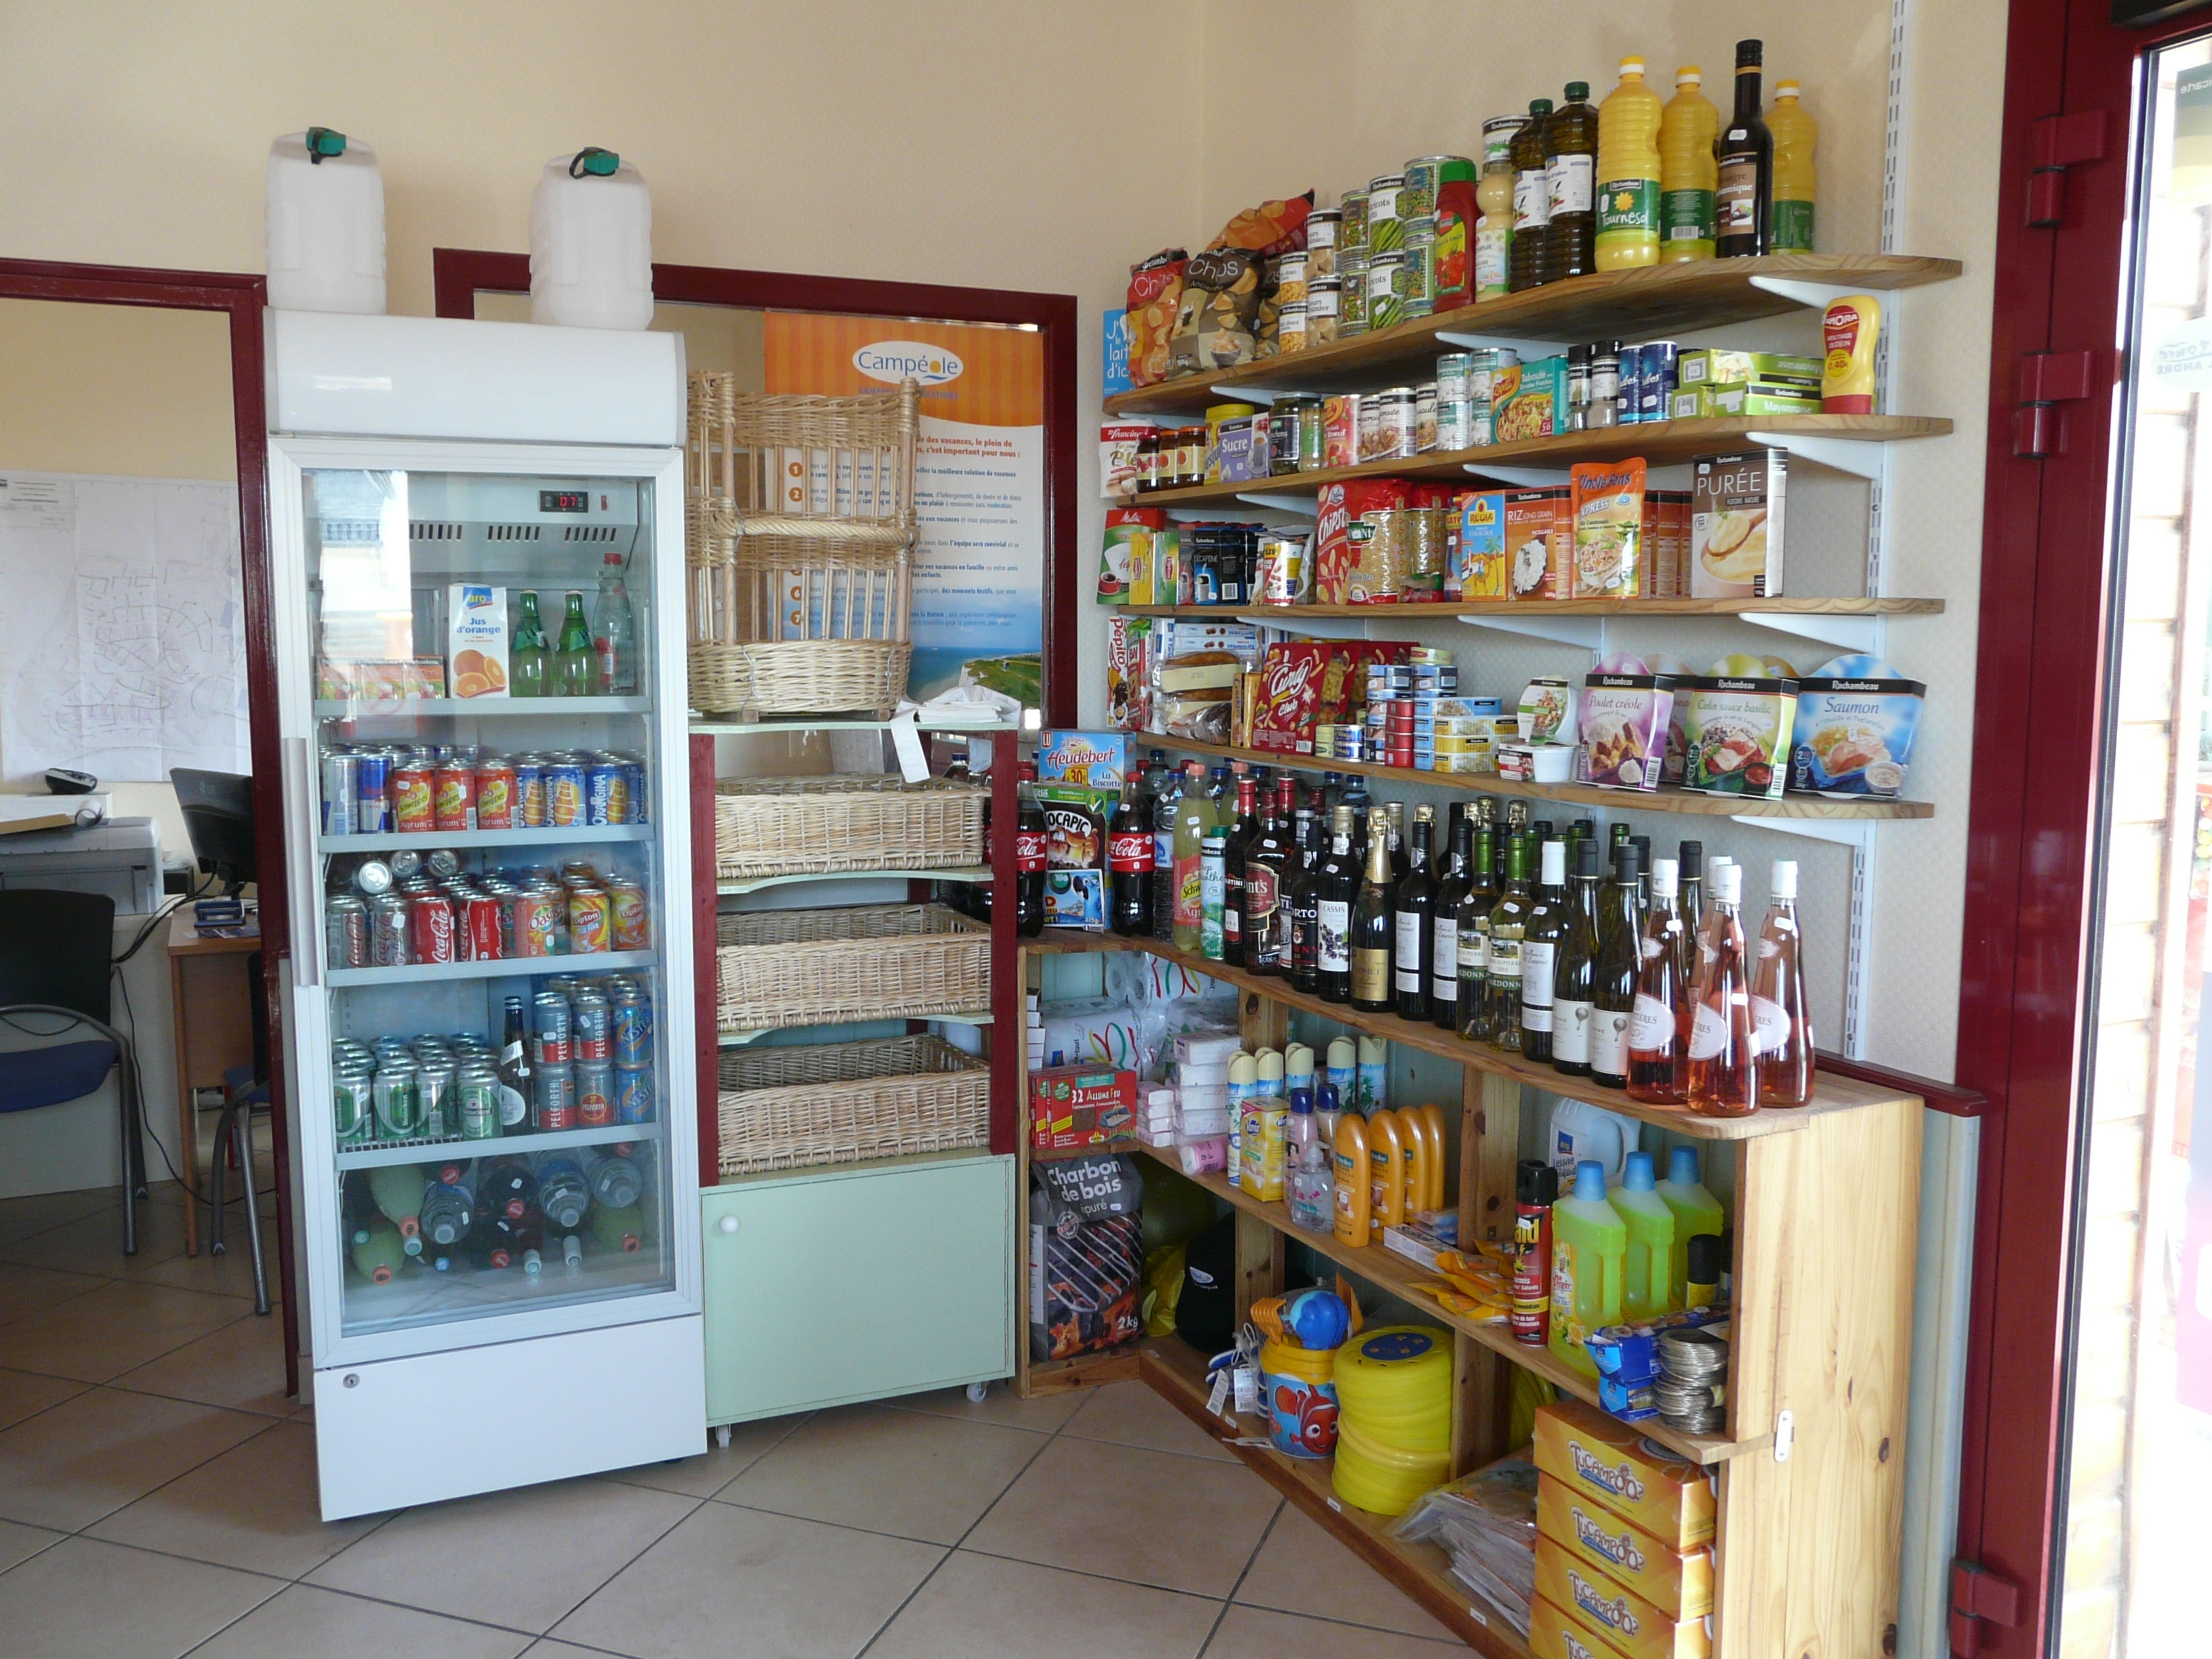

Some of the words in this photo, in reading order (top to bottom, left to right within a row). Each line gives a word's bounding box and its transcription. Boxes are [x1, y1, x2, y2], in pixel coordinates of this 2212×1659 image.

[859, 351, 958, 376] Campéole
[1107, 363, 1128, 379] d'ic
[1763, 400, 1813, 414] Mayonnaise
[940, 437, 975, 446] vacances,
[976, 438, 982, 446] le
[983, 439, 1002, 448] plein
[1003, 439, 1012, 447] de
[1222, 438, 1248, 453] Sucre
[926, 445, 943, 453] c'est
[943, 447, 980, 456] important
[981, 449, 998, 458] pour
[1696, 467, 1763, 497] PURÉE
[1579, 498, 1610, 516] XPRESS
[1469, 512, 1494, 523] REGIA
[1507, 510, 1523, 521] RIZ
[469, 595, 487, 603] aro
[469, 617, 487, 626] Jus
[456, 625, 501, 636] d'orange
[1110, 618, 1126, 666] Pépito
[1271, 663, 1310, 697] Curly
[1602, 676, 1633, 687] Rochambeau
[1717, 680, 1755, 690] Rochambeau
[1832, 680, 1880, 691] Rochambeau
[1589, 695, 1614, 708] Poulet
[1615, 695, 1643, 710] créole
[1697, 699, 1718, 711] Colin
[1719, 701, 1743, 712] sauce
[1744, 701, 1773, 714] basilic
[1824, 696, 1880, 714] Saumon
[1047, 745, 1117, 771] Heudebert
[1101, 771, 1111, 779] La
[1092, 779, 1123, 788] Biscotte
[1226, 878, 1244, 887] ARTINI
[1323, 905, 1345, 914] CASSIS
[573, 912, 600, 926] Lipton
[556, 1012, 567, 1061] PELFORTH
[594, 1009, 606, 1059] PELFORTH
[549, 1080, 562, 1128] PELFORTH
[1071, 1089, 1084, 1104] 32
[1047, 1158, 1122, 1187] Charbon
[1061, 1187, 1079, 1203] de
[1080, 1176, 1122, 1200] bois
[1080, 1197, 1108, 1218] épuré
[1515, 1218, 1540, 1244] aid
[1118, 1317, 1126, 1330] 2
[1126, 1316, 1139, 1330] kg
